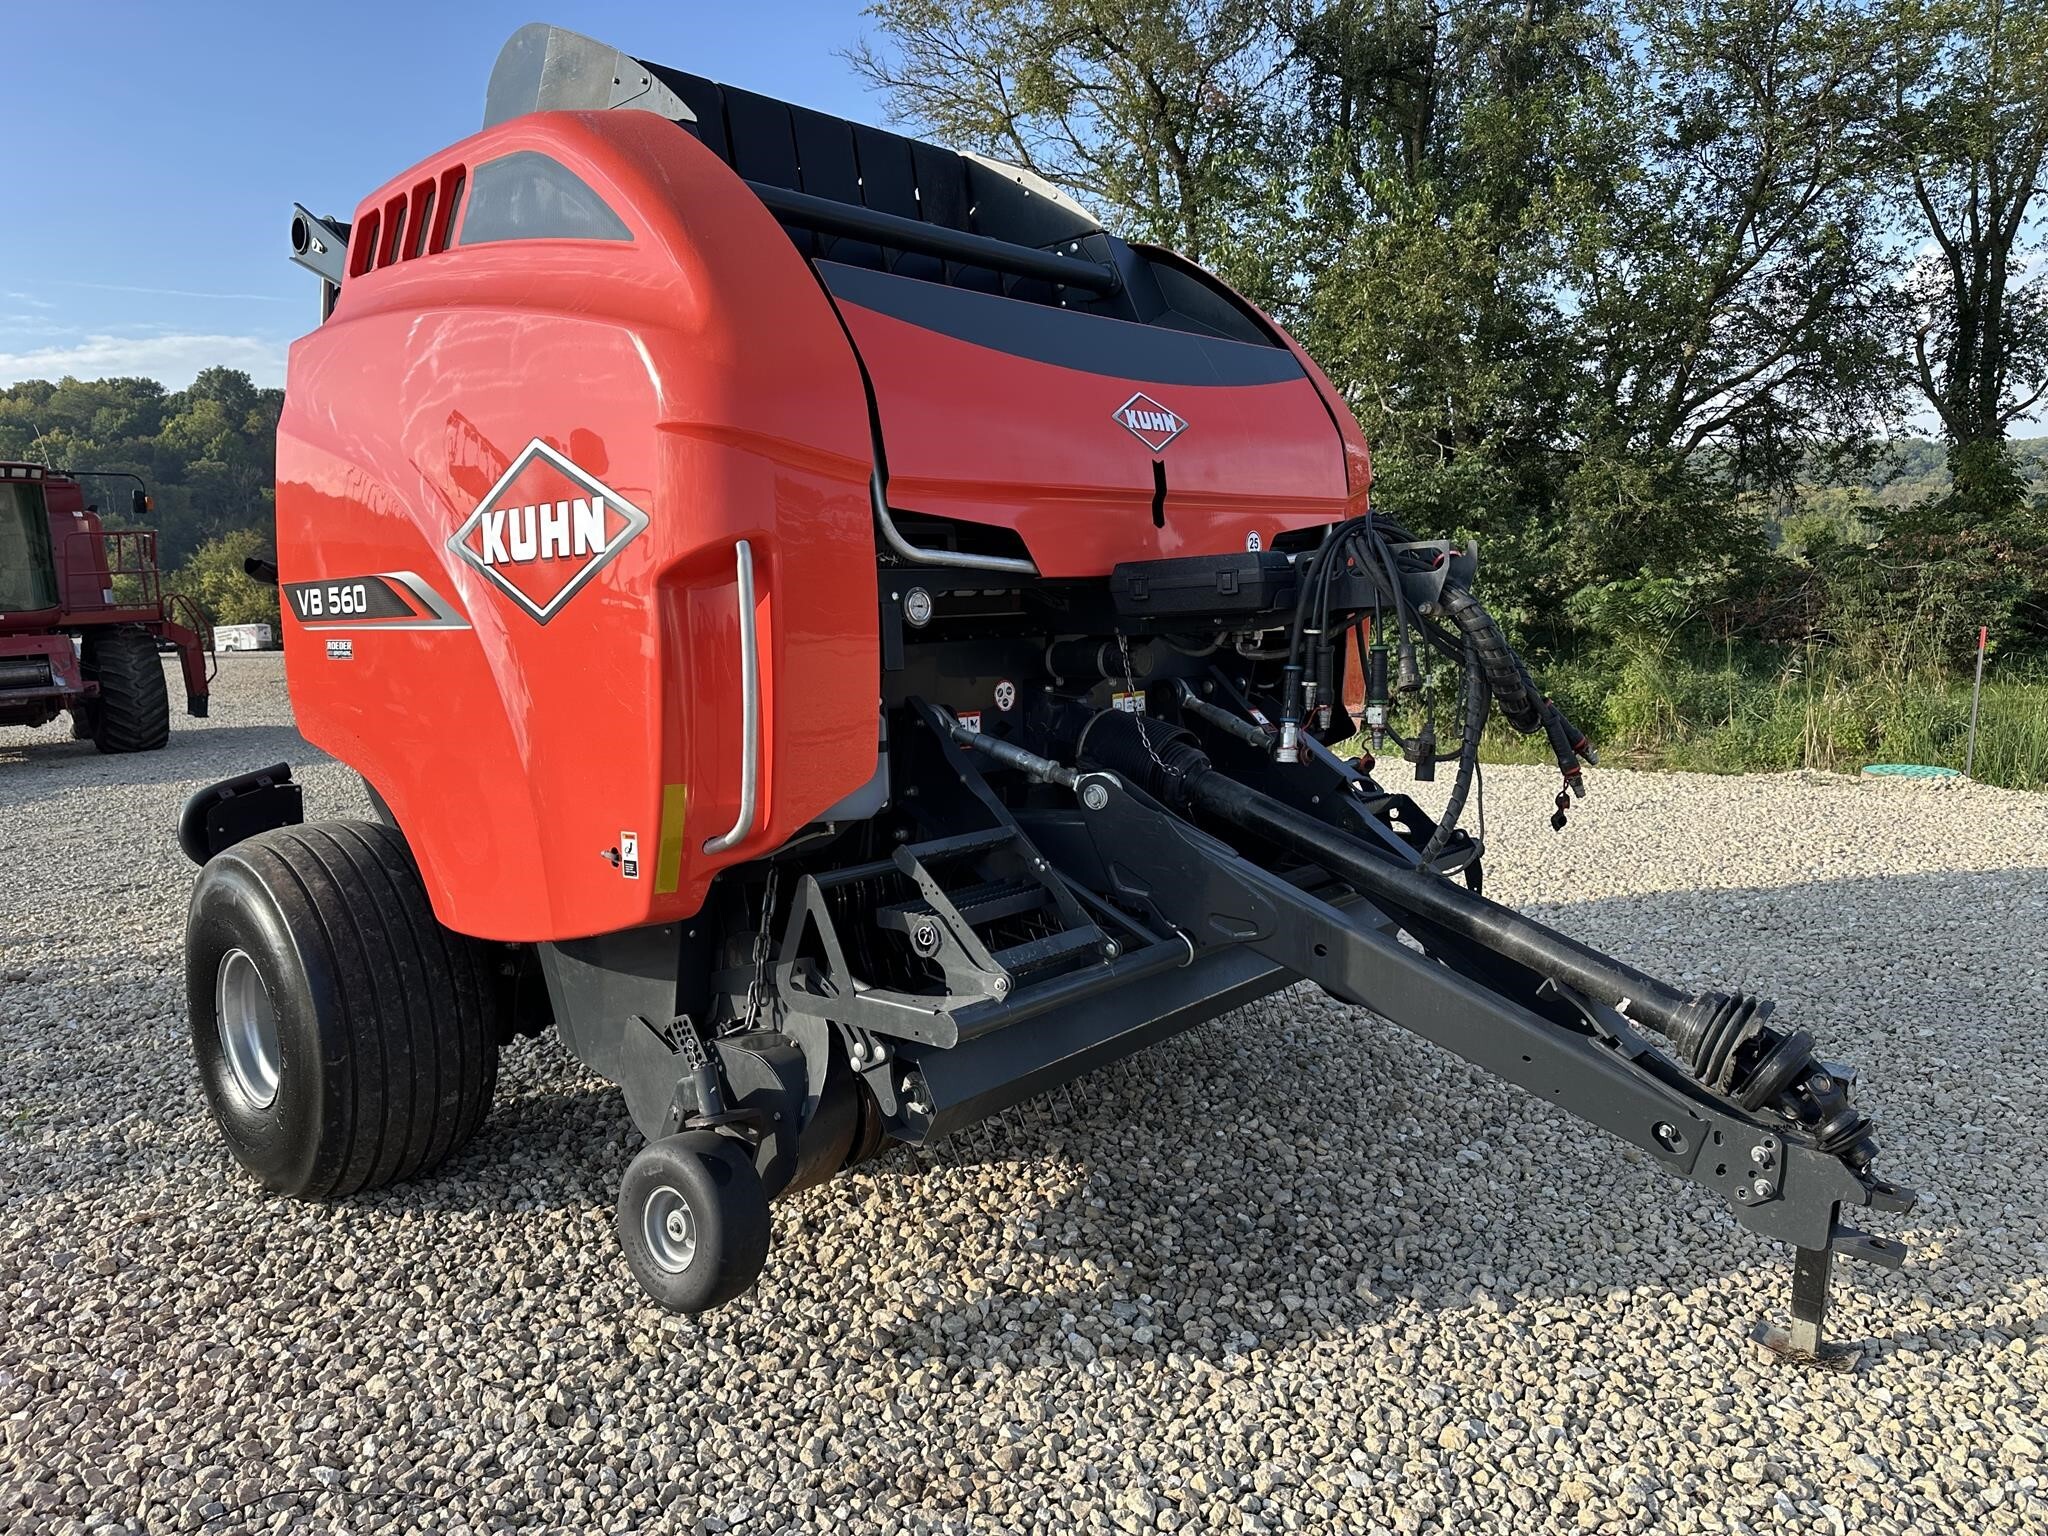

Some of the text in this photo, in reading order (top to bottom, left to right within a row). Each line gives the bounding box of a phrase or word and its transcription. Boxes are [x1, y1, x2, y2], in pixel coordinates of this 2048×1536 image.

[1124, 409, 1177, 432] KUHN
[480, 495, 606, 565] KUHN
[1249, 537, 1259, 549] 25
[296, 584, 367, 616] VB 560
